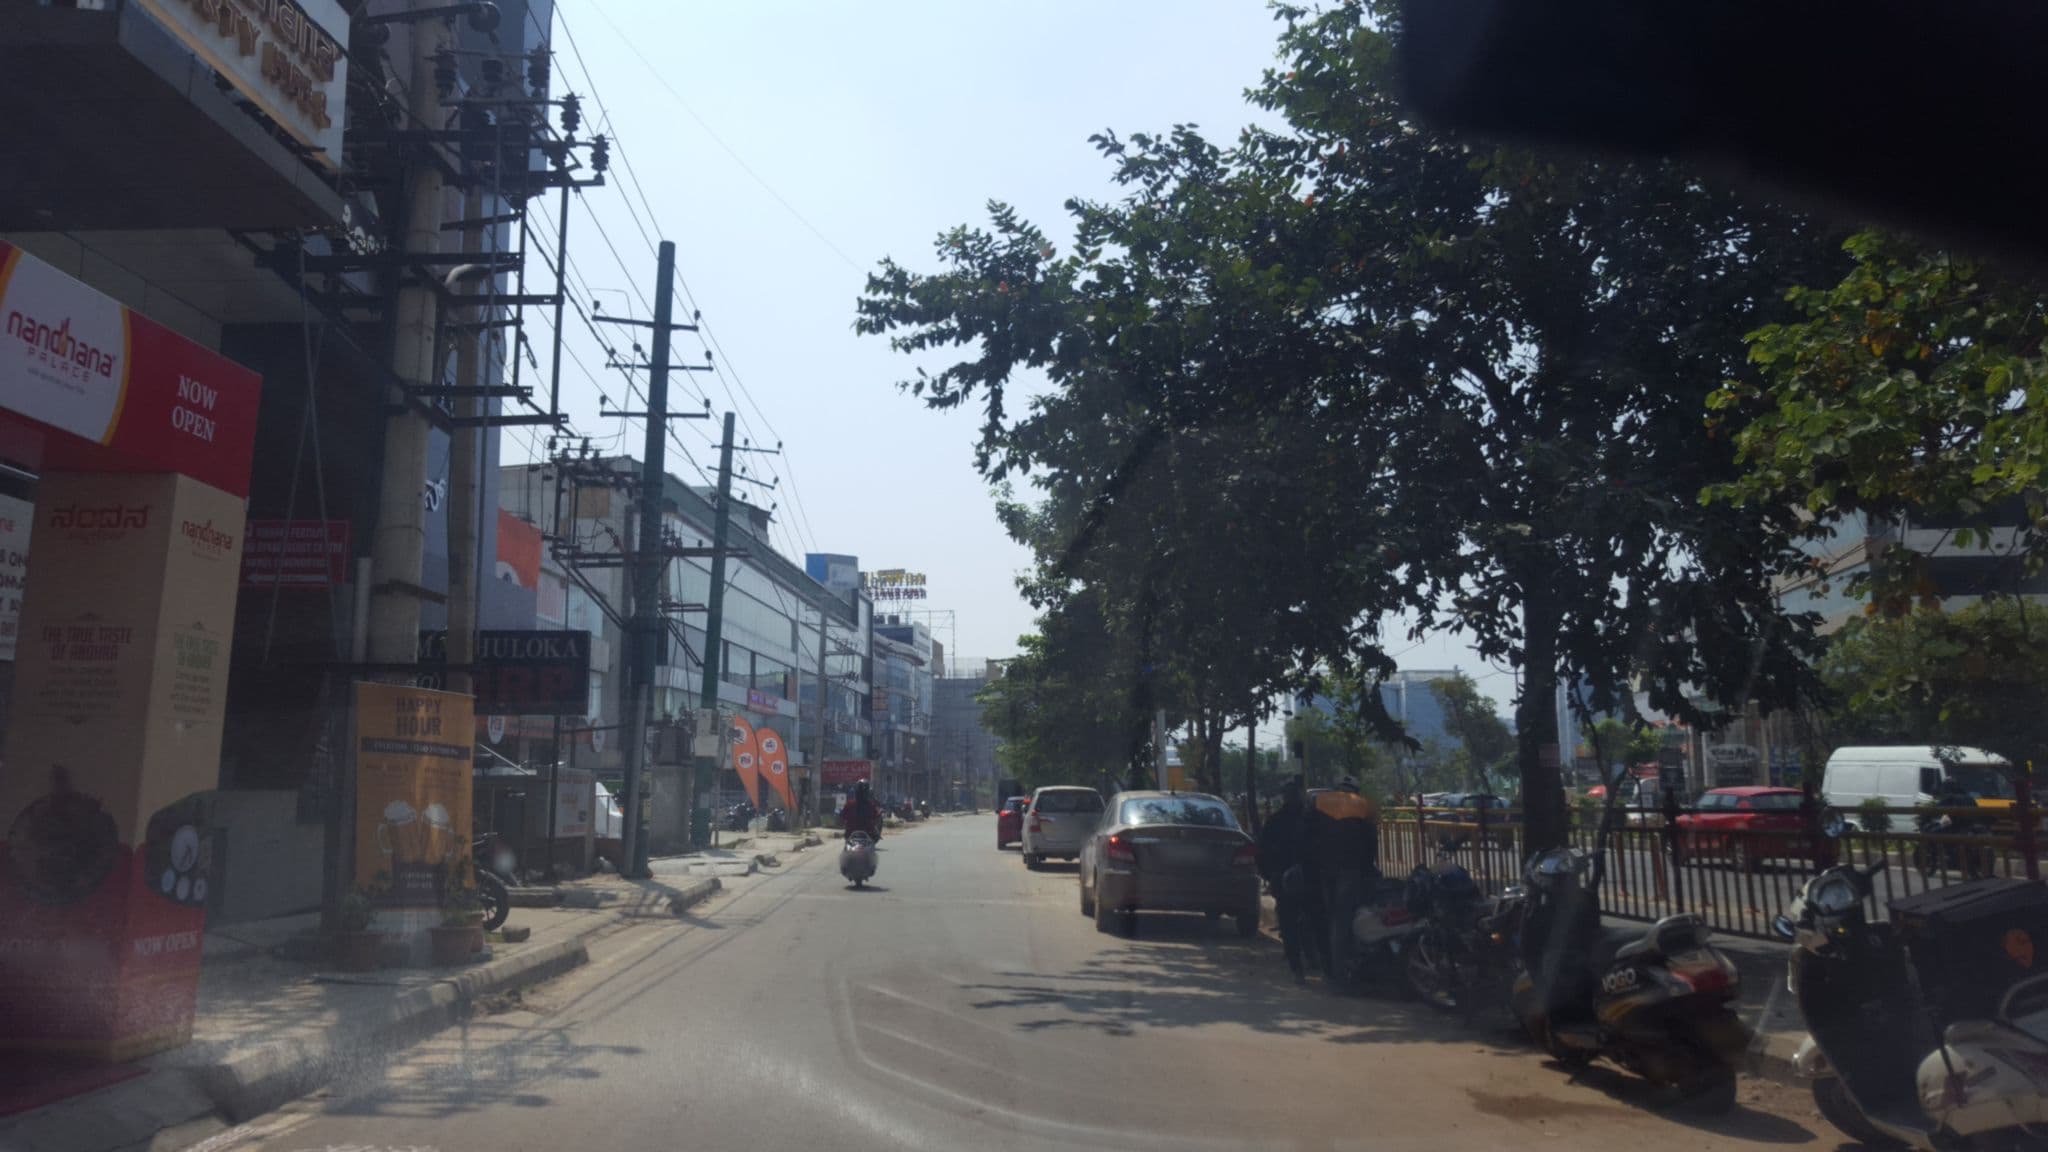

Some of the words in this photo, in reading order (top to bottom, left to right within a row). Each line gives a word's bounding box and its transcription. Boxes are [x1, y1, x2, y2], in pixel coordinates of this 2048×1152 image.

[7, 311, 113, 378] nandhana
[27, 346, 90, 383] PALACE
[177, 375, 218, 412] NOW
[172, 405, 216, 443] OPEN
[182, 519, 233, 550] nandhana
[395, 696, 441, 714] HAPPY
[396, 716, 442, 737] HOUR
[166, 930, 198, 953] OPEN
[1601, 967, 1637, 993] VOGO
